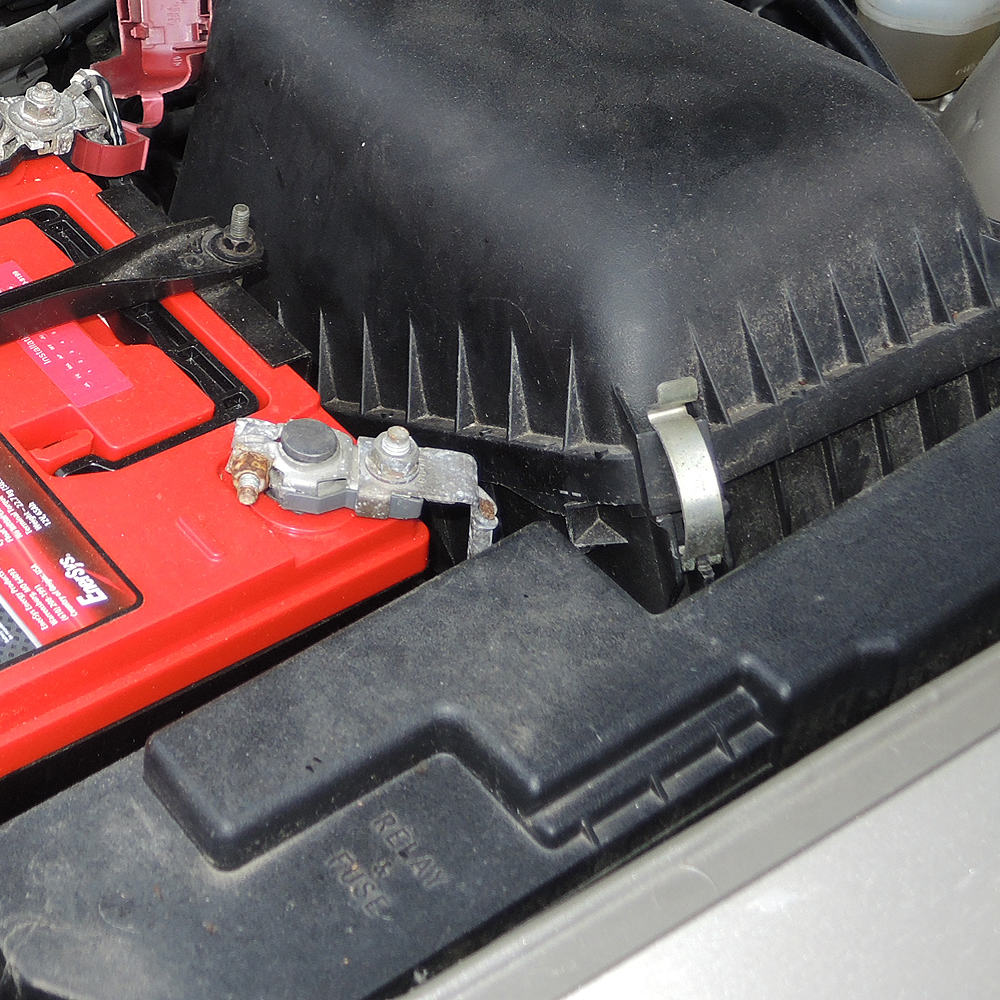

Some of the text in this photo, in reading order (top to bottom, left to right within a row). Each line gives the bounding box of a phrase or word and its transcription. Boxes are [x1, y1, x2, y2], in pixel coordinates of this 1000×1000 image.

[3, 488, 17, 498] kg
[8, 494, 24, 509] 22.7
[0, 513, 18, 531] Initial
[9, 510, 34, 535] Terminal
[21, 509, 45, 531] Weight
[11, 528, 24, 539] No
[19, 582, 32, 593] MO
[28, 562, 80, 617] Country of Origin: USA
[12, 590, 35, 611] Energy
[26, 608, 50, 631] EnerSys
[369, 809, 453, 890] RELAY
